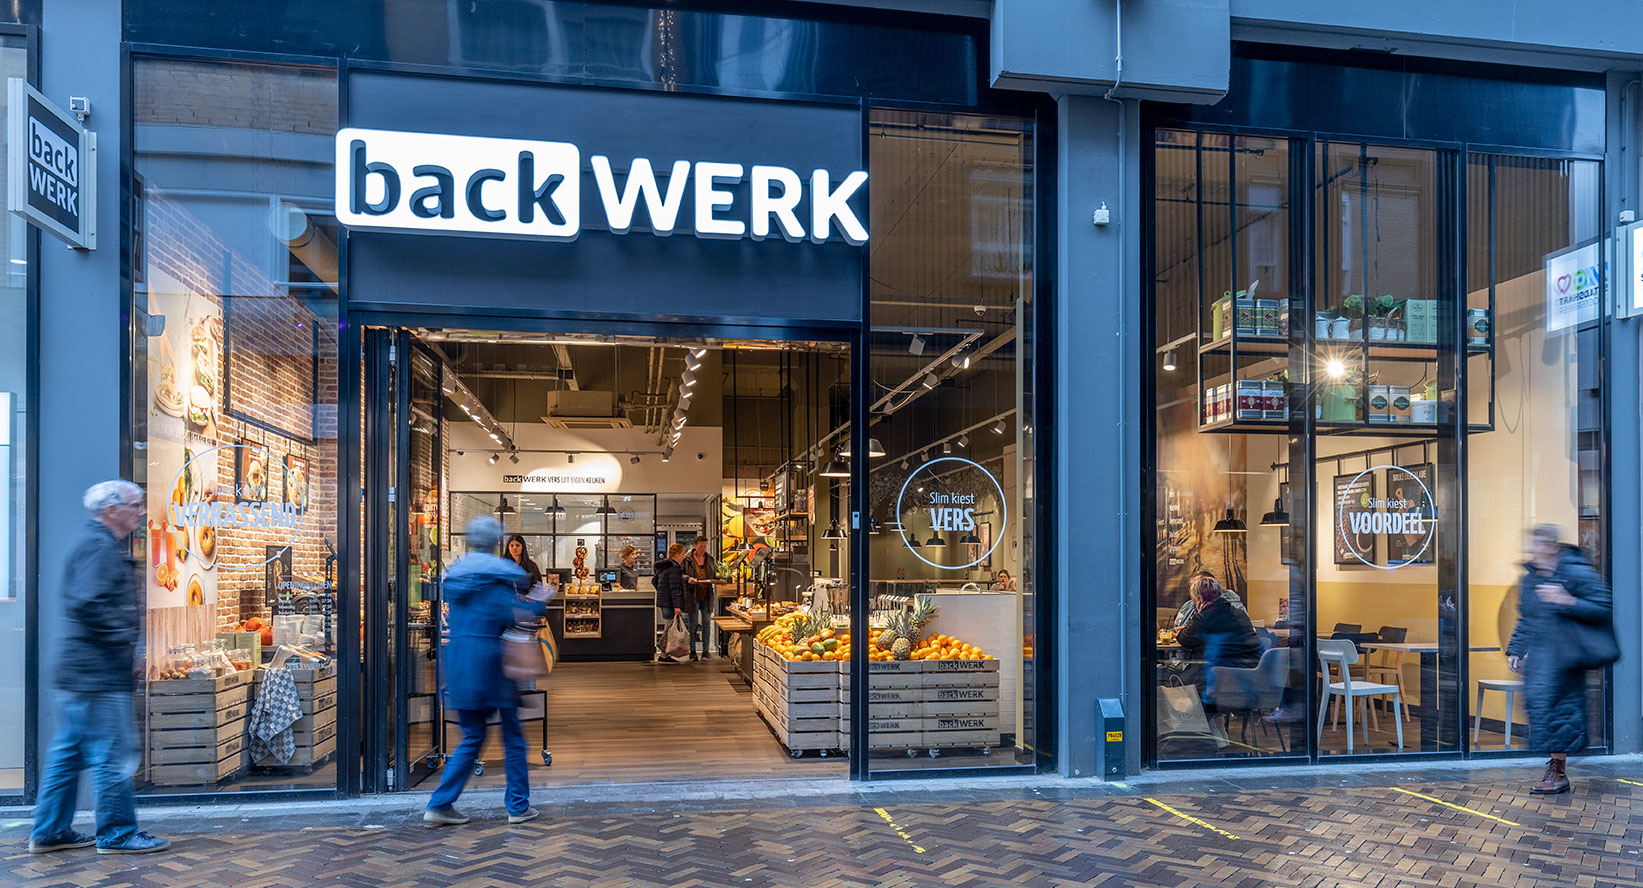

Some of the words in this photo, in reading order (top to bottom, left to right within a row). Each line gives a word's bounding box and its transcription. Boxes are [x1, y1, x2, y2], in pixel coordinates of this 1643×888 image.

[32, 121, 76, 180] back
[28, 161, 79, 217] WERK
[350, 139, 566, 225] back
[591, 155, 869, 243] WERK
[547, 476, 560, 484] VERS
[586, 476, 605, 484] KEUKEN
[208, 483, 233, 497] Slim
[235, 483, 264, 497] kiest
[929, 492, 949, 504] Slim
[951, 492, 975, 504] kiest
[1368, 497, 1385, 509] Slim
[1387, 497, 1407, 509] kiest
[173, 501, 297, 528] VERRASSEND
[930, 507, 975, 531] VERS
[1349, 512, 1426, 534] VOORDEEL
[939, 661, 958, 669] back
[960, 661, 985, 669] WERK
[881, 692, 901, 700] WERK
[938, 691, 958, 699] back
[960, 690, 984, 698] WERK
[939, 720, 958, 728] back
[960, 719, 985, 727] WERK
